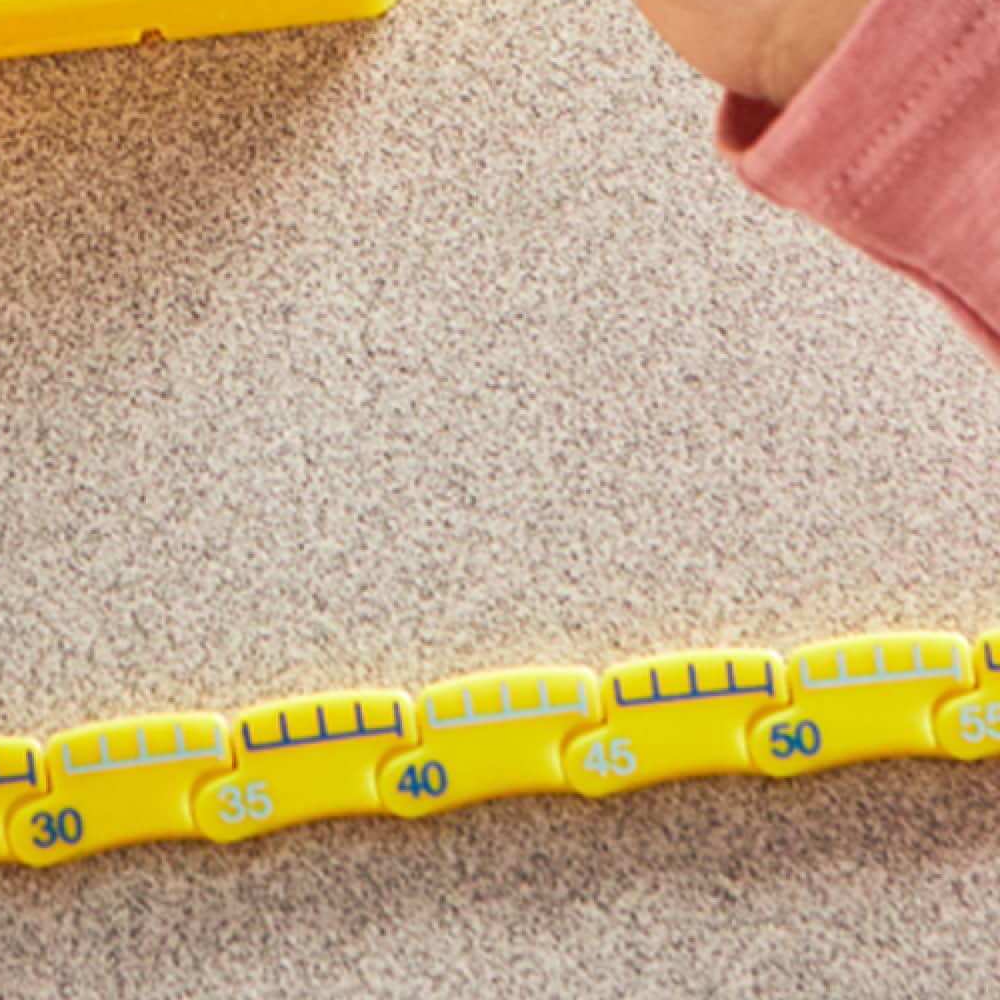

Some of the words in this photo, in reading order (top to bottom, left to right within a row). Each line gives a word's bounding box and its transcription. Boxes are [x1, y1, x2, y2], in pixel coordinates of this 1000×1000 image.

[582, 737, 638, 777] 45
[769, 719, 822, 759] 50
[397, 760, 448, 799] 40
[216, 781, 274, 824] 35
[30, 807, 84, 849] 30
